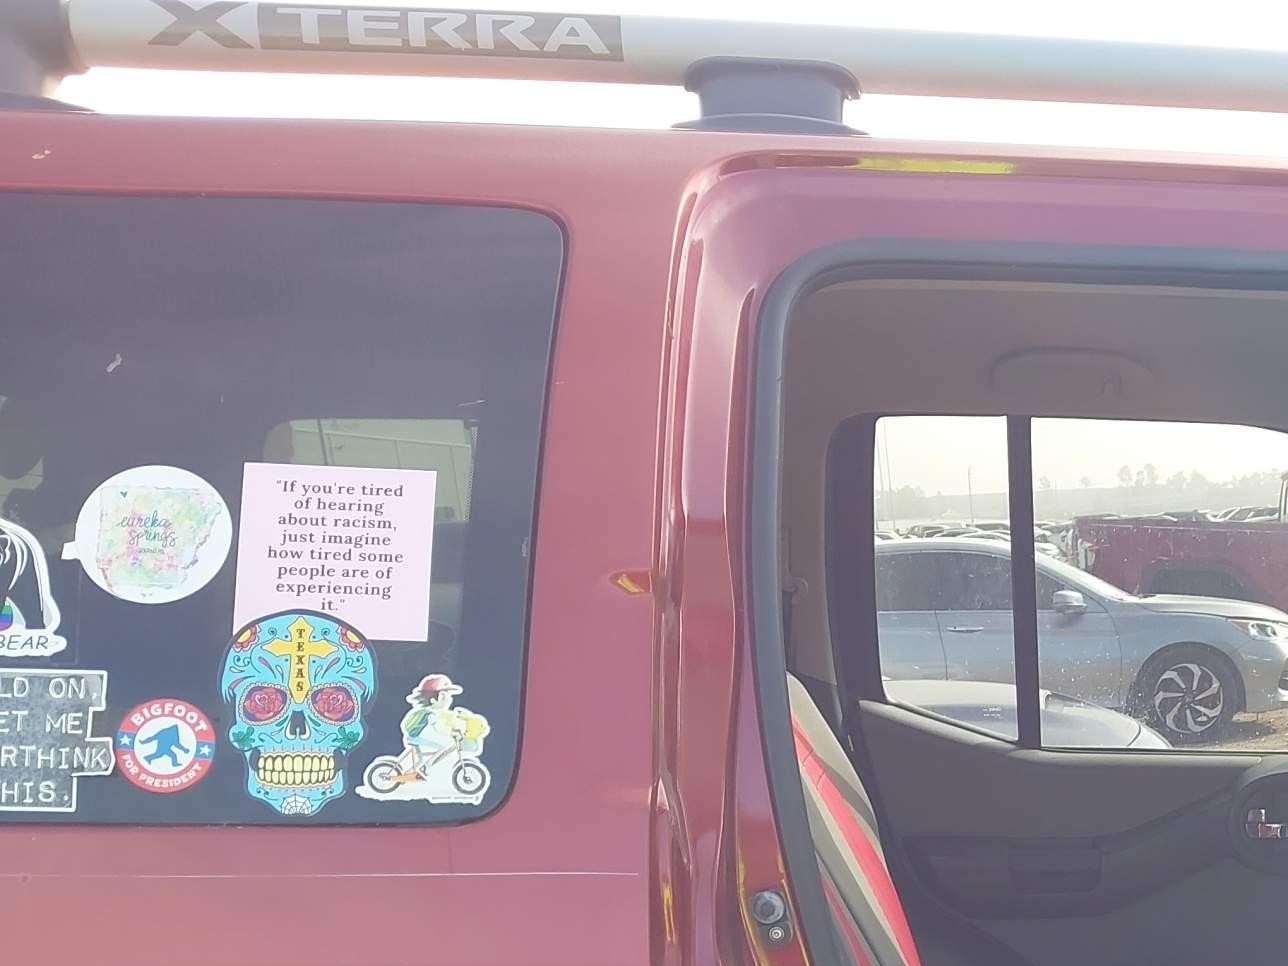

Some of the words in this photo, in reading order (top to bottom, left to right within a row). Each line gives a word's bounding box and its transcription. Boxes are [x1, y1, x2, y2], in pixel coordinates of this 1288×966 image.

[276, 480, 298, 493] "If
[302, 482, 355, 497] you're
[361, 484, 404, 497] tired
[294, 497, 312, 510] of
[317, 498, 385, 516] hearing
[278, 513, 327, 527] about
[333, 516, 397, 532] racism,
[280, 530, 316, 546] just
[321, 531, 391, 549] imagine
[267, 546, 304, 560] how
[310, 548, 352, 561] tired
[358, 551, 404, 563] some
[277, 564, 336, 580] people
[341, 567, 370, 578] are
[375, 567, 393, 579] of
[276, 581, 393, 600] experiencing
[321, 598, 345, 611] it."
[295, 628, 306, 692] TEXAS
[0, 677, 29, 698] LD
[48, 677, 97, 700] ON,
[0, 710, 29, 733] ET
[45, 713, 83, 734] ME
[130, 702, 208, 732] BIGFOOT
[0, 745, 108, 769] RTHINK
[122, 754, 139, 775] FOR
[139, 762, 203, 788] PRESIDENT
[0, 781, 69, 803] HIS.
